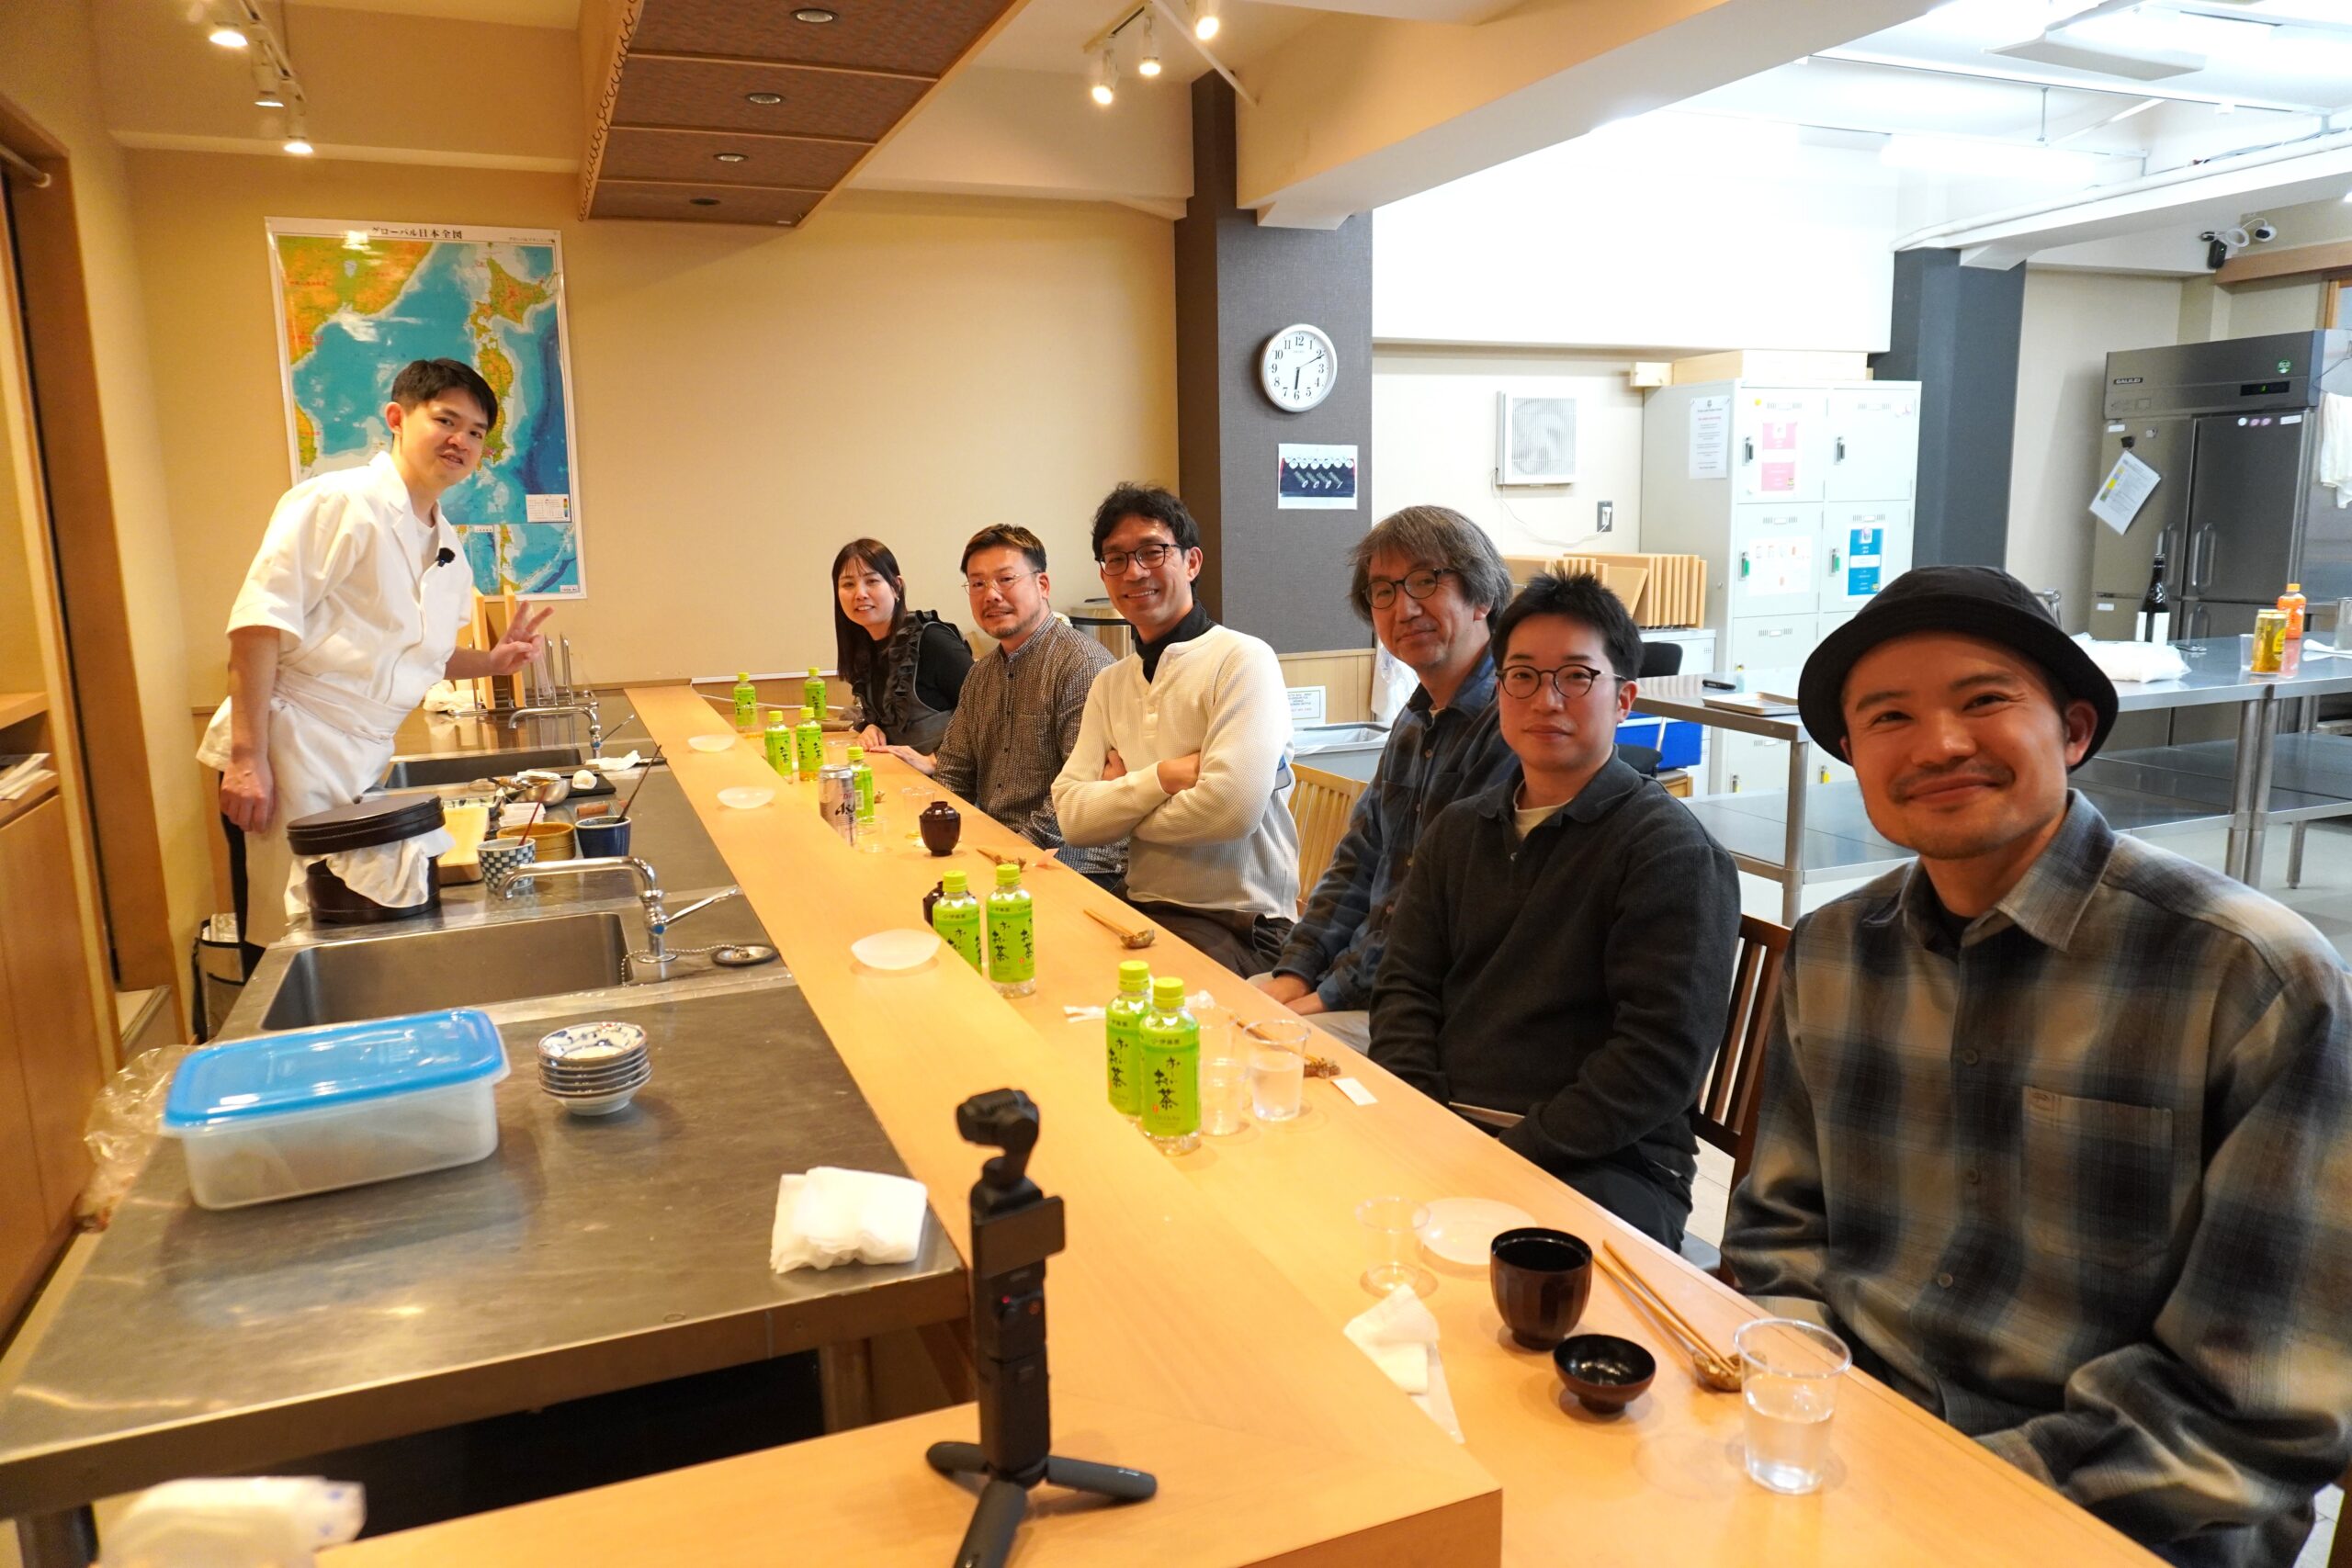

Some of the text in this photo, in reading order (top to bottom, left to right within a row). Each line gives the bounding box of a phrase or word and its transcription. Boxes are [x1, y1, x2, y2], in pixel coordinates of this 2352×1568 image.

[372, 226, 462, 240] グローバル日本全図
[1284, 340, 1291, 350] 11
[1295, 336, 1304, 346] 12
[1309, 340, 1313, 350] 1
[1274, 350, 1283, 360] 10
[1316, 349, 1322, 359] 2
[1272, 363, 1278, 374] 9
[1318, 364, 1324, 374] 3
[1274, 377, 1280, 387] 8
[1314, 377, 1319, 388] 4
[1283, 387, 1288, 397] 7
[1294, 390, 1300, 400] 6
[1306, 387, 1312, 397] 5
[1154, 1068, 1179, 1111] お茶
